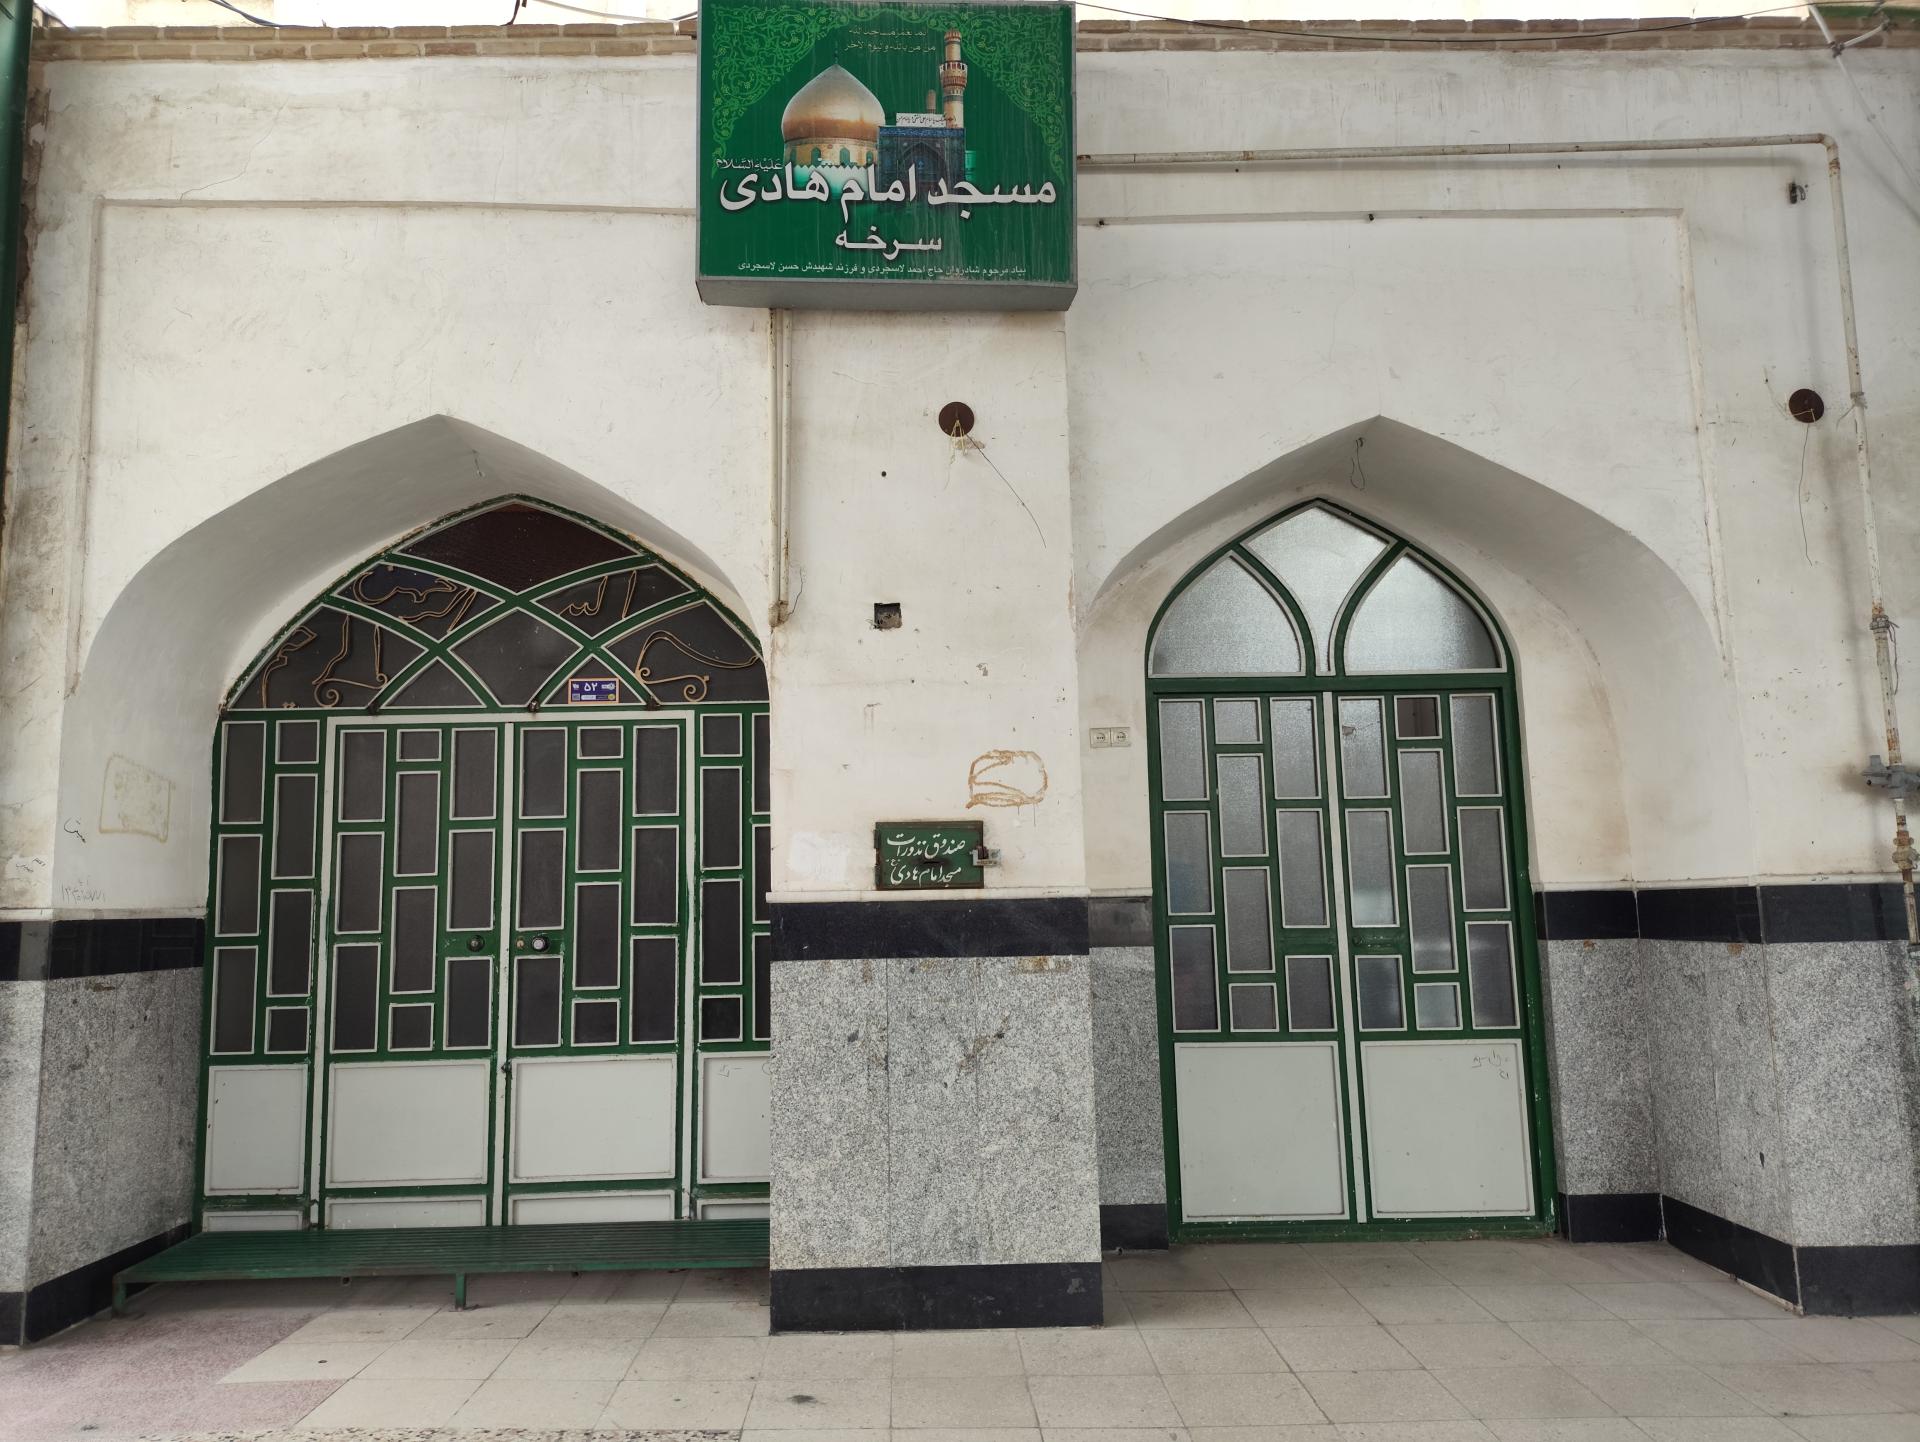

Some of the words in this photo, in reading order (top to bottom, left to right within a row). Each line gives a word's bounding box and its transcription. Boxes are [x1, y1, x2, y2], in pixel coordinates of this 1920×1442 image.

[719, 162, 830, 210] هادی
[841, 165, 916, 221] امام
[927, 182, 1057, 219] مسجد
[835, 226, 942, 260] سرخه
[738, 262, 776, 272] لاسجردی
[778, 263, 799, 272] حسن
[801, 262, 833, 273] شهیدش
[835, 264, 858, 274] فرزند
[859, 265, 865, 274] و
[867, 264, 905, 275] لاسجردی
[907, 265, 926, 273] احمد
[928, 265, 944, 277] حاج
[945, 265, 980, 276] شادروان
[982, 266, 1009, 277] مرحوم
[583, 682, 598, 691] ۵۲
[886, 833, 926, 857] نذورات
[924, 833, 966, 860] صندوق
[890, 864, 919, 885] هادی
[918, 865, 943, 887] امام
[938, 866, 962, 888] مسجد
